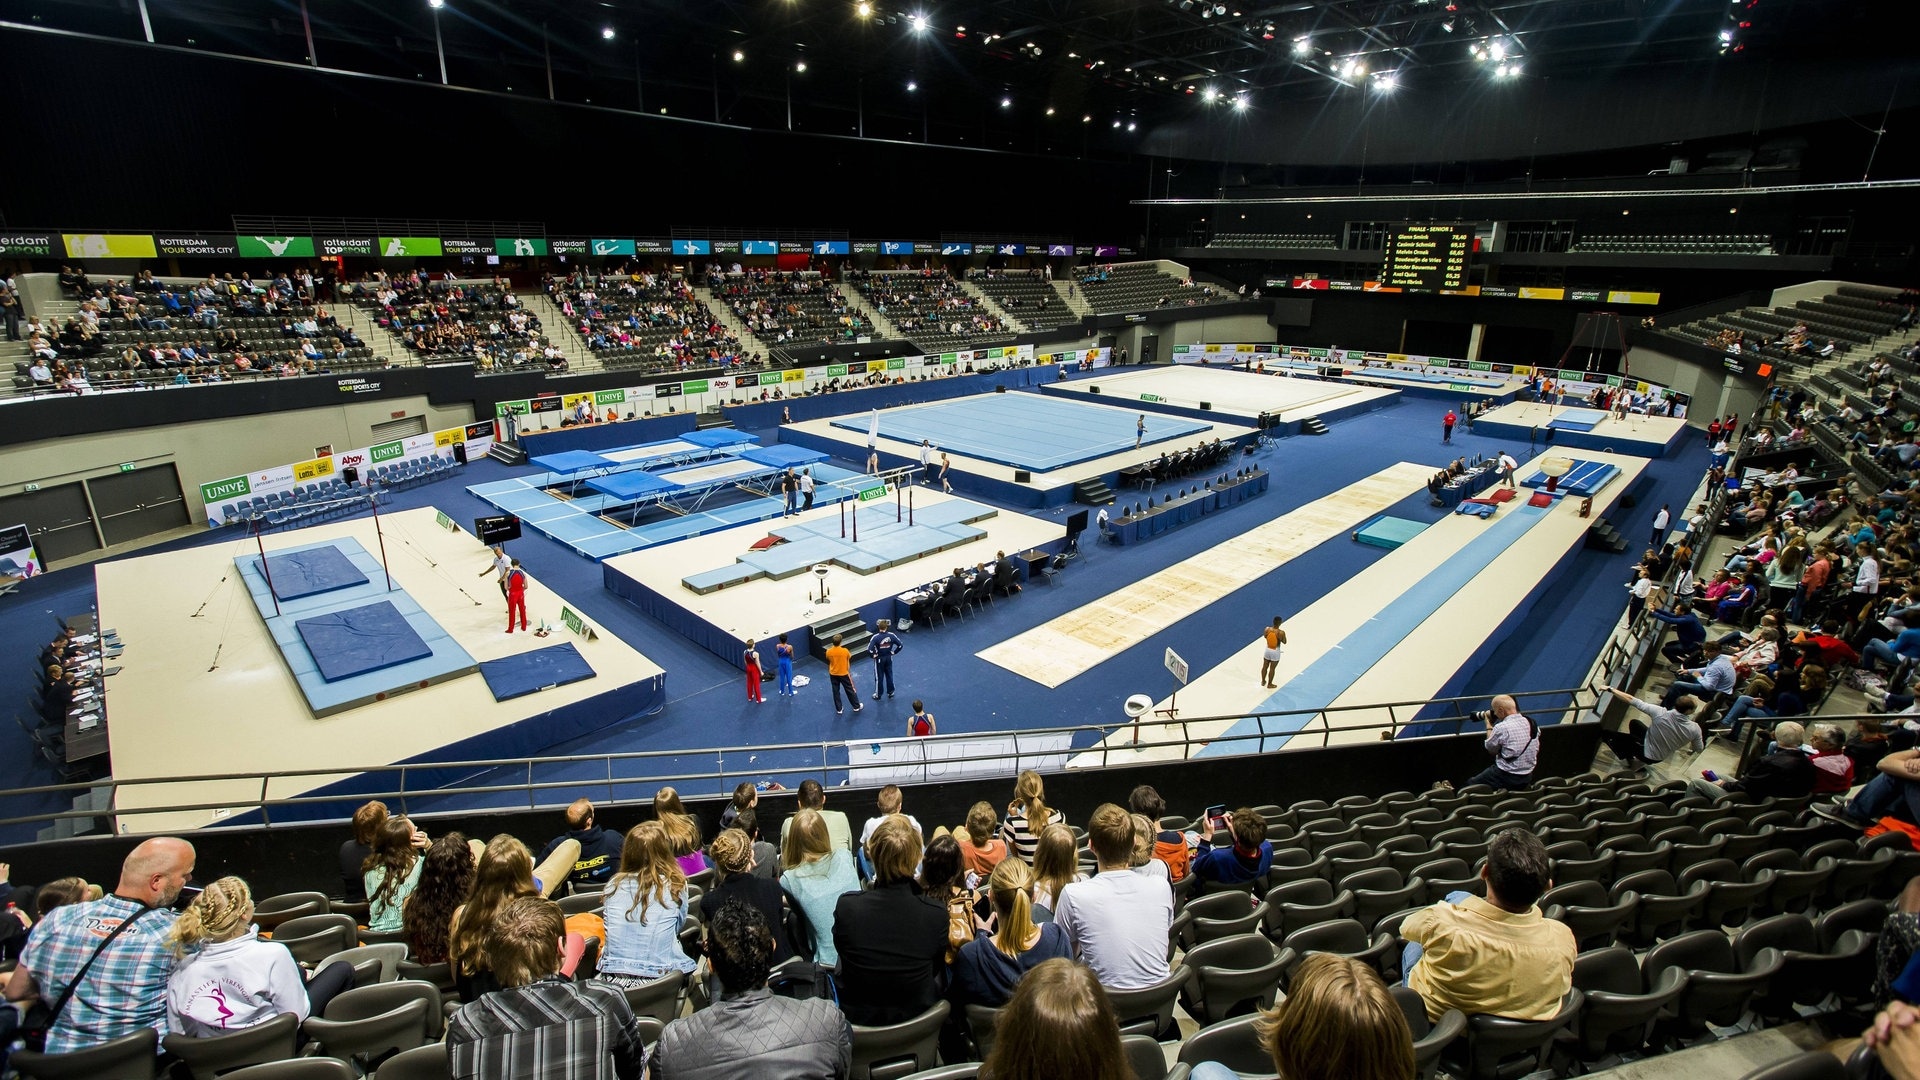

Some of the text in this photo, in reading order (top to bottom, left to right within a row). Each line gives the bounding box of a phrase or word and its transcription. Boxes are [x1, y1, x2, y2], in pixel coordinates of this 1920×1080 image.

[160, 238, 208, 246] ROTTERDAM
[598, 391, 623, 404] UNIVÉ
[374, 444, 402, 460] UNIVÉ
[206, 479, 247, 499] UNIVÉ
[862, 486, 886, 500] UNIVÉ
